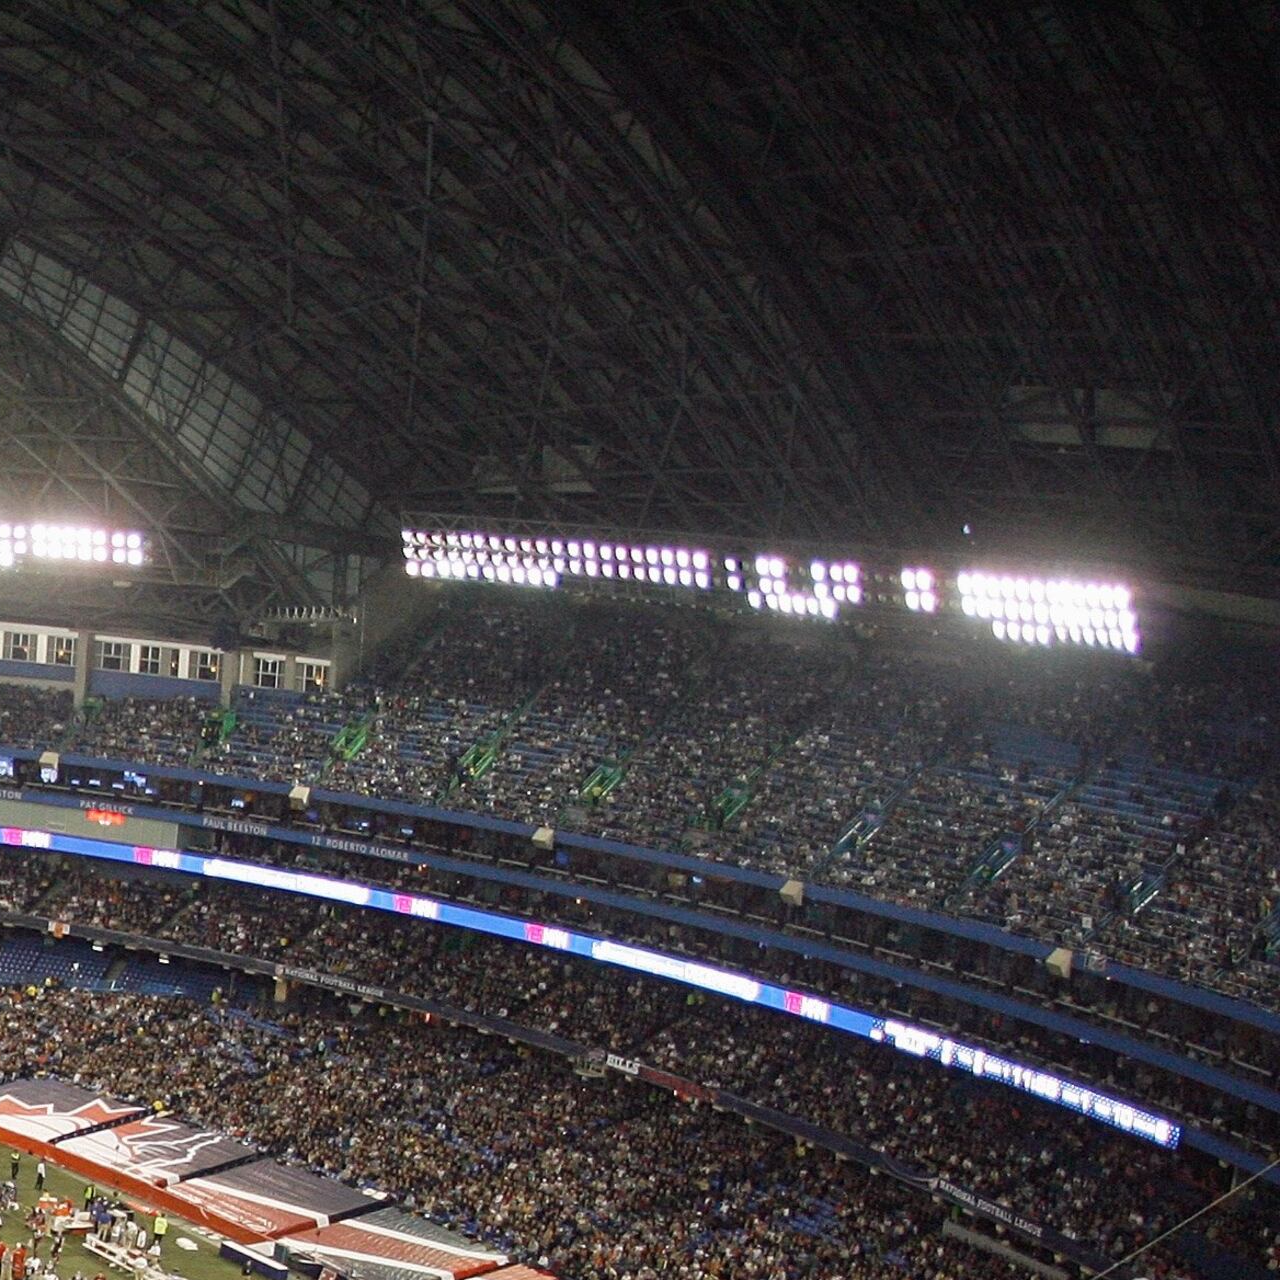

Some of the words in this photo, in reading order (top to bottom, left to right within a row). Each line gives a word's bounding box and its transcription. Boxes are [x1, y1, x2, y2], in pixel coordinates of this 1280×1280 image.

[80, 799, 96, 810] PAT
[99, 802, 134, 815] GILLICK
[203, 817, 225, 830] PAUL
[326, 838, 366, 854] ROBERTO
[369, 847, 409, 862] ALOMAR
[940, 1179, 976, 1207] NATIONAL
[977, 1198, 1012, 1223] FOOTBALL
[1013, 1216, 1043, 1239] LEAGUE
